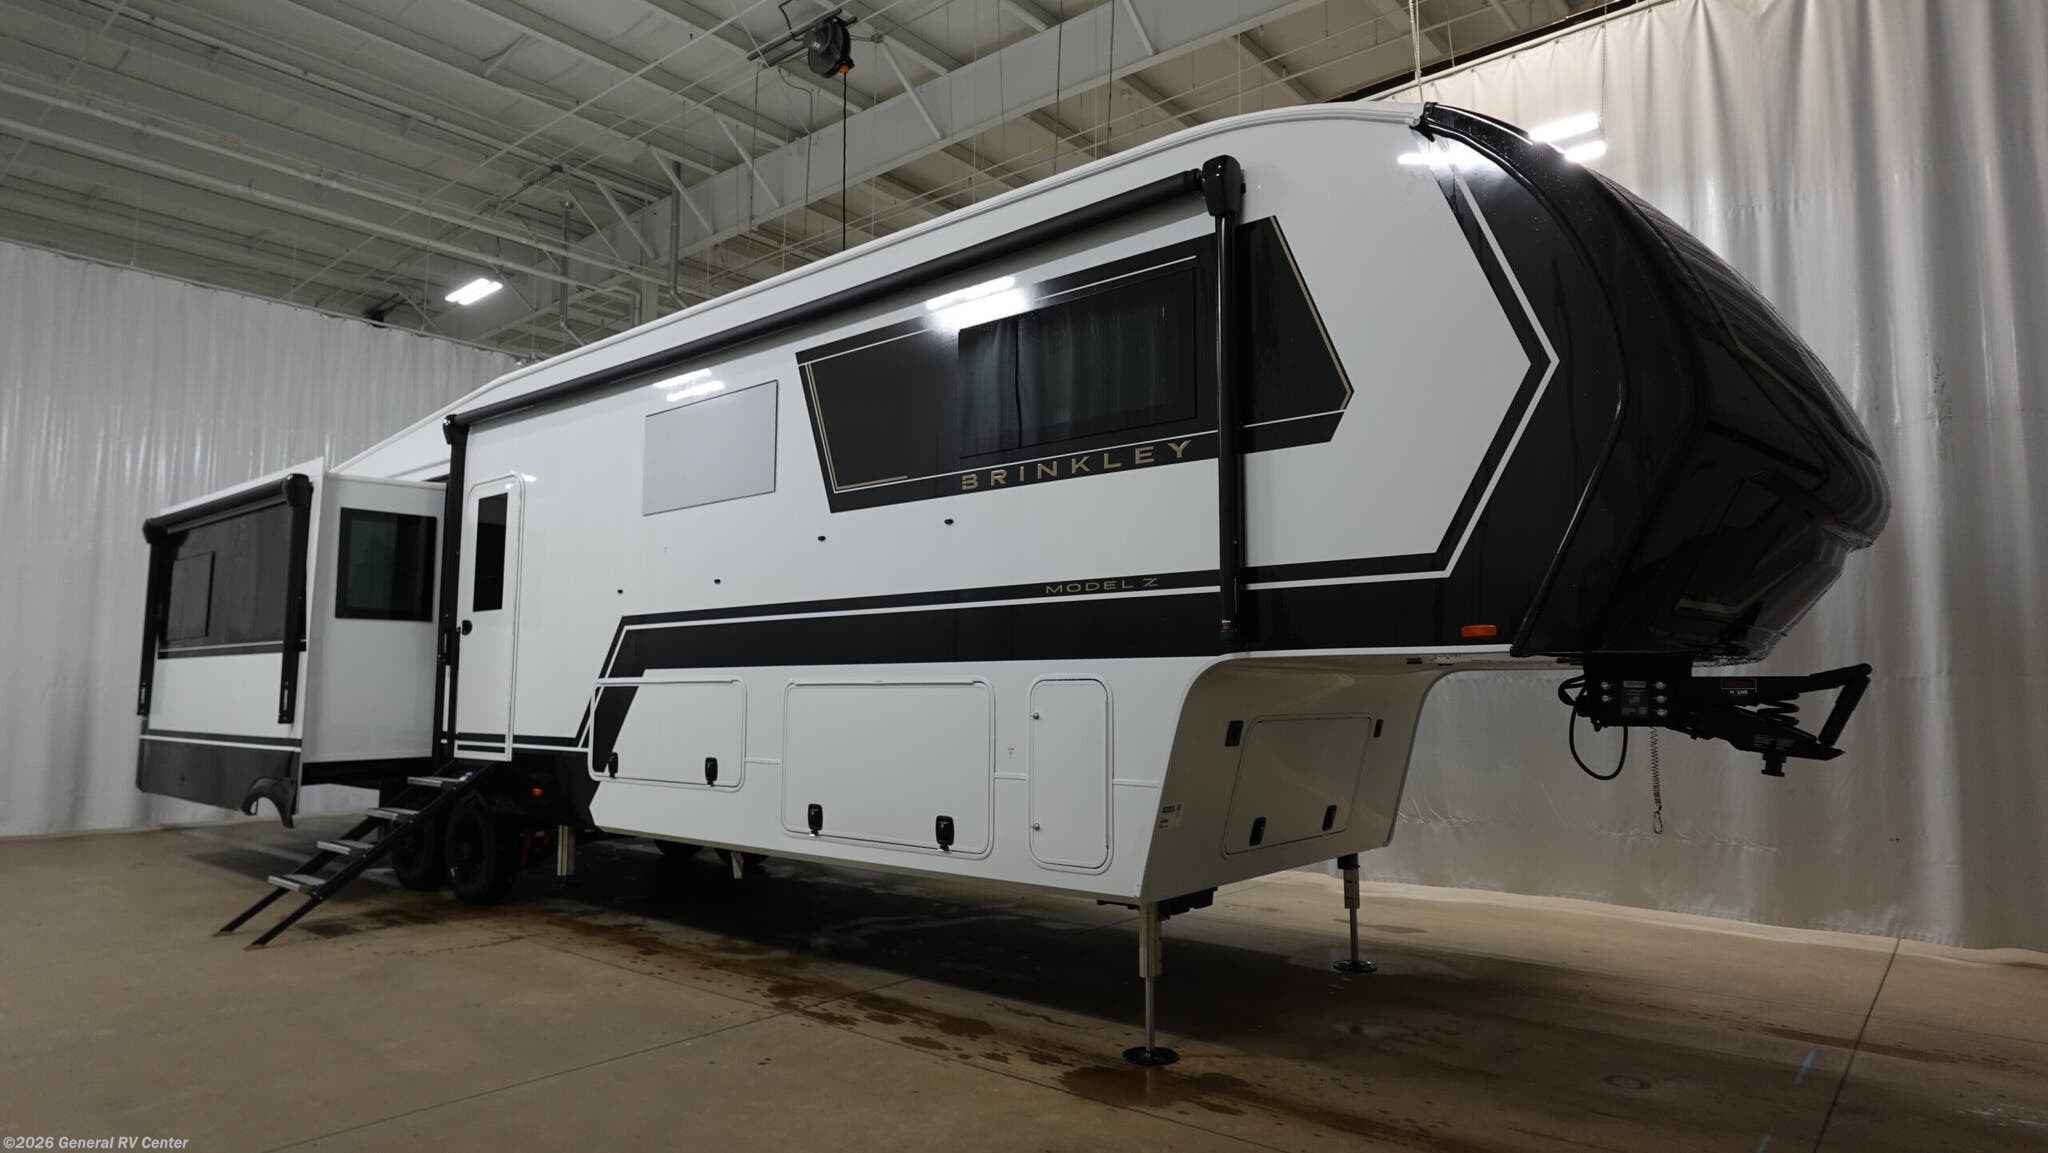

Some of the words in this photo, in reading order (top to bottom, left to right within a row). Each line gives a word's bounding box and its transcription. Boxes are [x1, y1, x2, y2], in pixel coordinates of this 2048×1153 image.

[961, 439, 1191, 491] BRINKLEY
[1045, 579, 1134, 594] MODEL
[1143, 577, 1160, 588] Z
